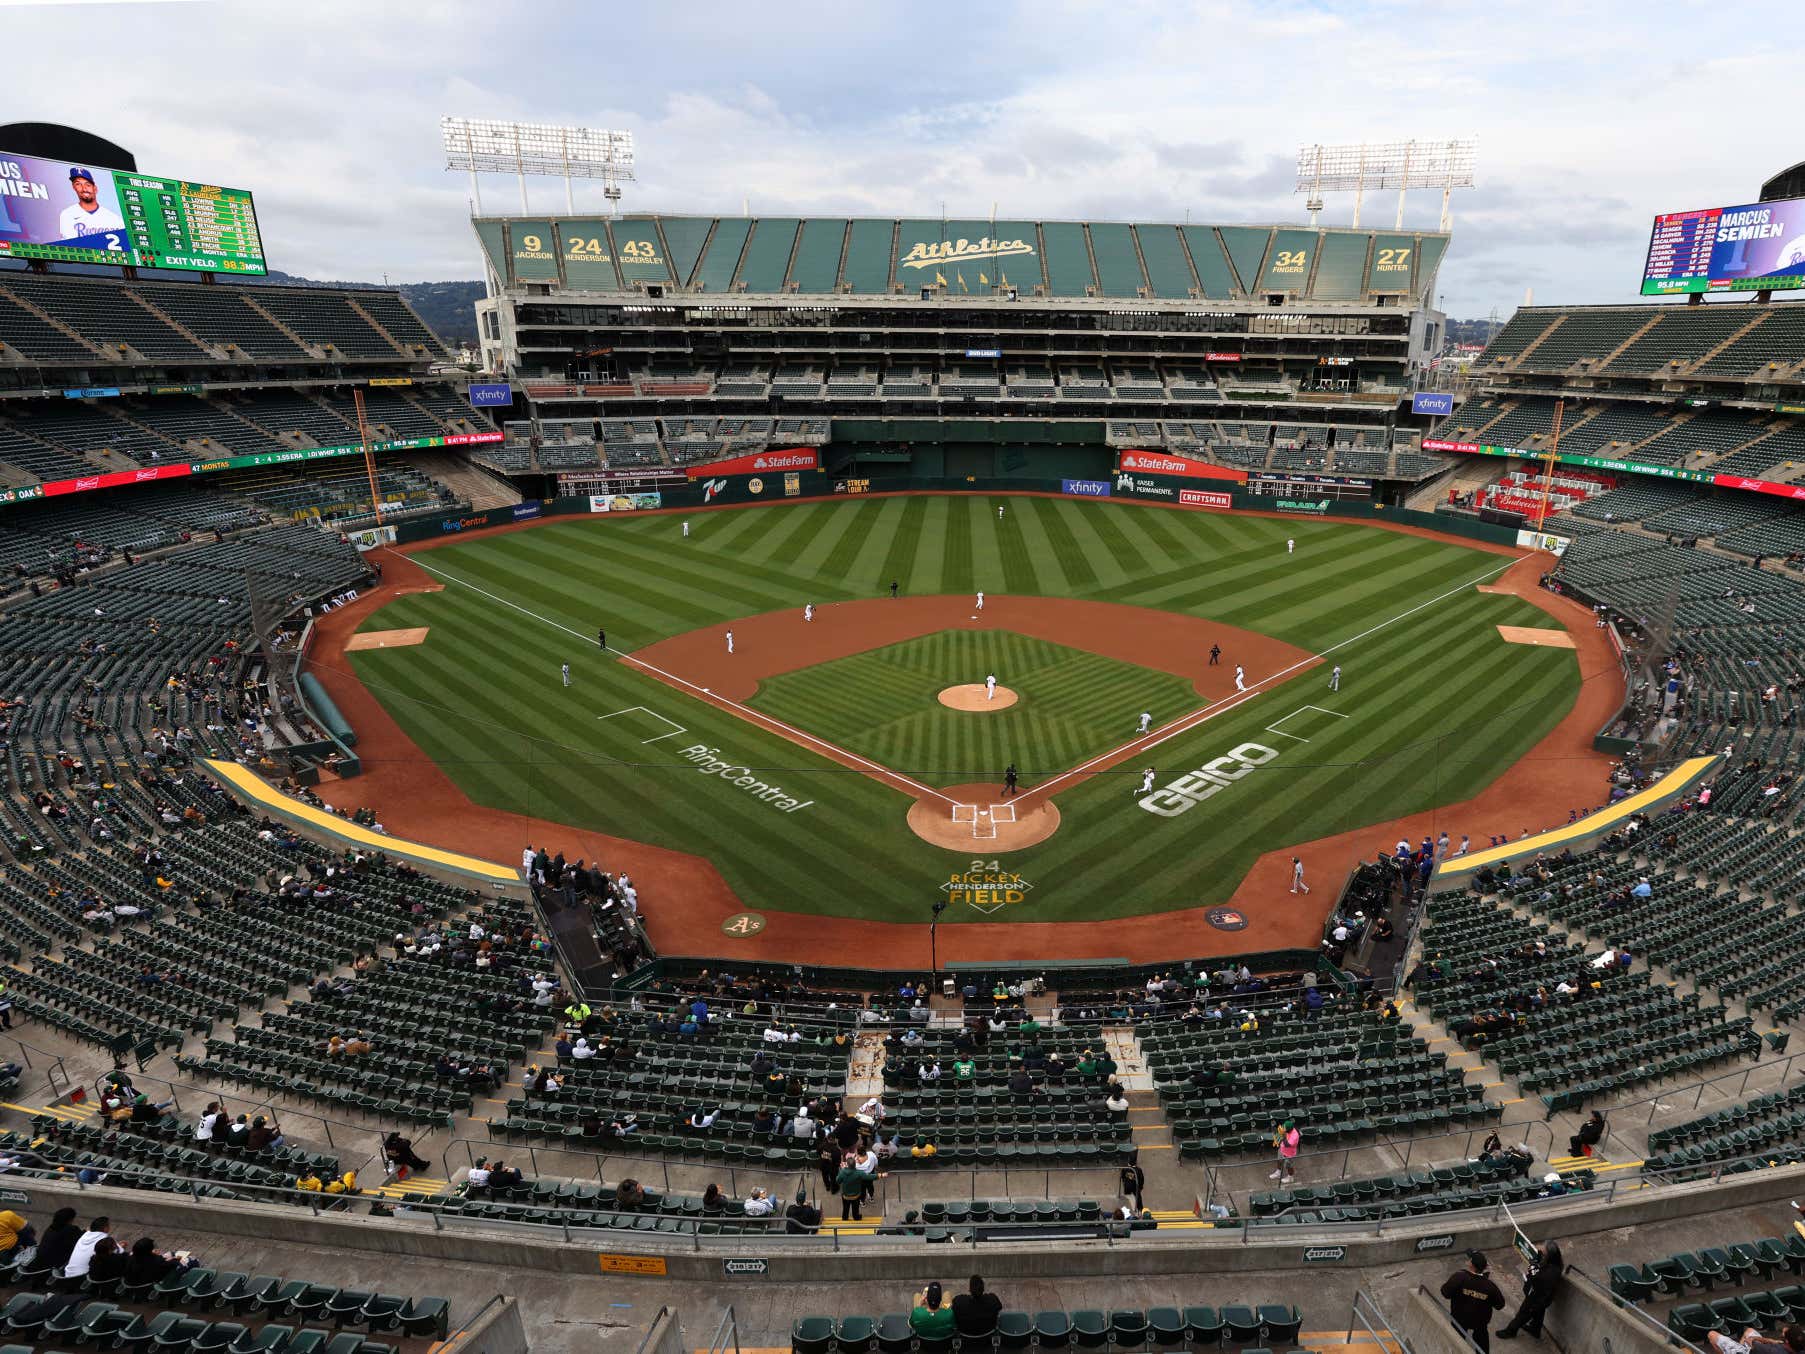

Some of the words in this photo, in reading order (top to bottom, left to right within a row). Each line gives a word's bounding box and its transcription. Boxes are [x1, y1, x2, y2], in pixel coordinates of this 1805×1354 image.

[1720, 209, 1770, 227] MARCUS
[1717, 222, 1784, 242] SEMIEN
[105, 234, 122, 251] 2
[523, 235, 542, 252] 9
[568, 238, 602, 254] 24
[623, 240, 656, 257] 43
[515, 251, 553, 260] JACKSON
[565, 254, 610, 262] HENDERSON
[901, 237, 1034, 269] Athletics
[1275, 251, 1306, 266] 34
[1378, 249, 1411, 265] 27
[166, 256, 187, 265] EXIT
[189, 258, 218, 268] VELO:
[619, 256, 663, 265] ECKERSLEY
[1272, 265, 1305, 273] FINGERS
[1376, 264, 1408, 272] HUNTER
[475, 390, 506, 400] xfinity
[1418, 398, 1448, 411] xfinity
[201, 461, 230, 471] MONTAS
[19, 488, 35, 499] OAK
[1069, 481, 1103, 495] xfinity
[1136, 486, 1174, 496] PERMANENTE
[1182, 493, 1228, 505] CRAFTSMAN
[676, 743, 816, 813] RingCentral
[1138, 742, 1280, 817] GEICO
[970, 860, 1001, 872] 24
[950, 873, 1022, 884] RICKEY
[948, 889, 1025, 904] FIELD
[725, 916, 761, 933] A's
